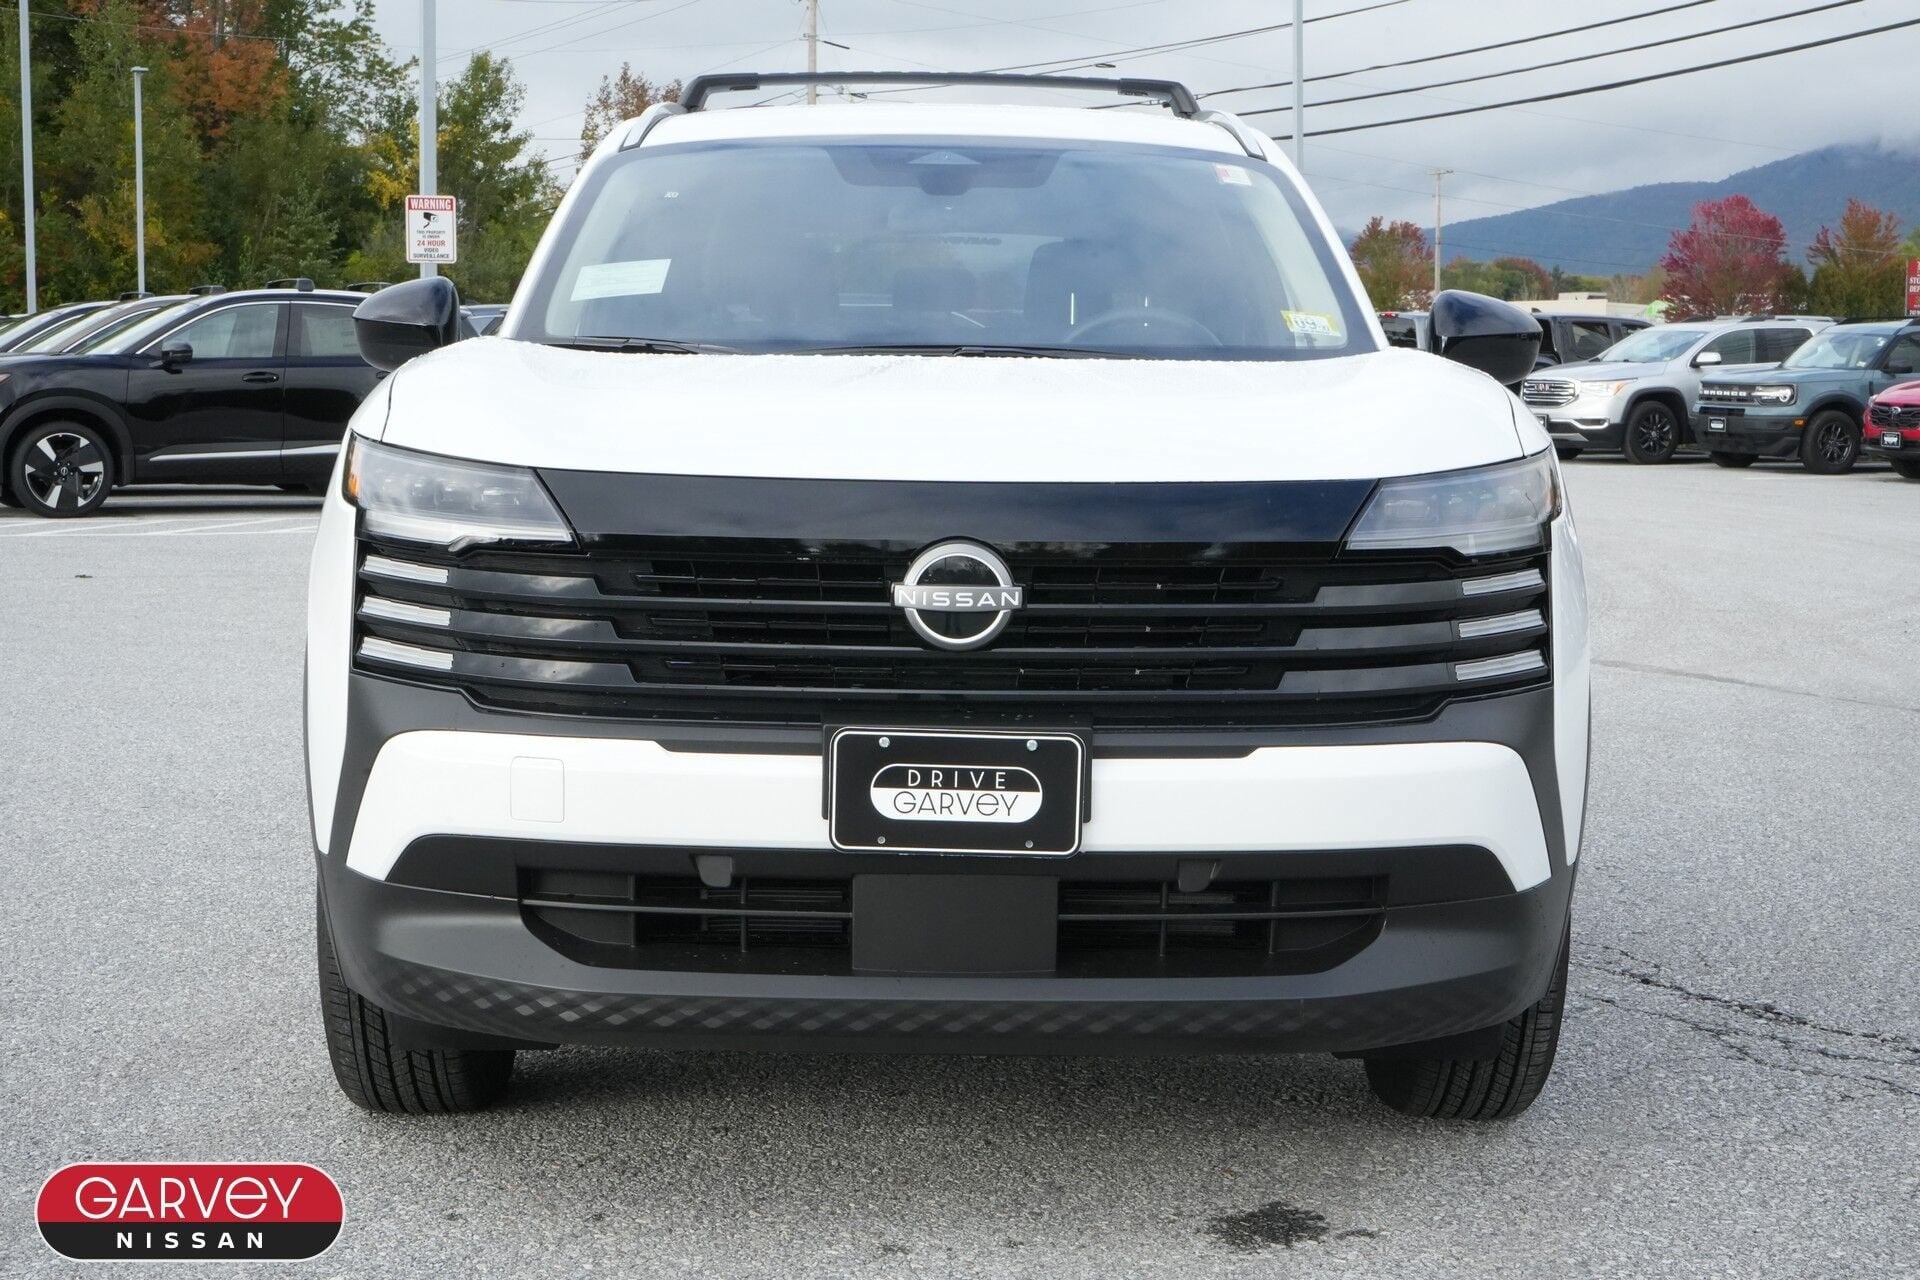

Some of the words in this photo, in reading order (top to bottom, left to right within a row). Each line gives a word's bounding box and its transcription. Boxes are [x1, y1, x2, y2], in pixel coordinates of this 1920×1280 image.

[411, 199, 451, 209] WARNING
[1703, 389, 1747, 397] BRONCO
[898, 590, 1020, 607] NISSAN
[907, 769, 1007, 789] DRIVE
